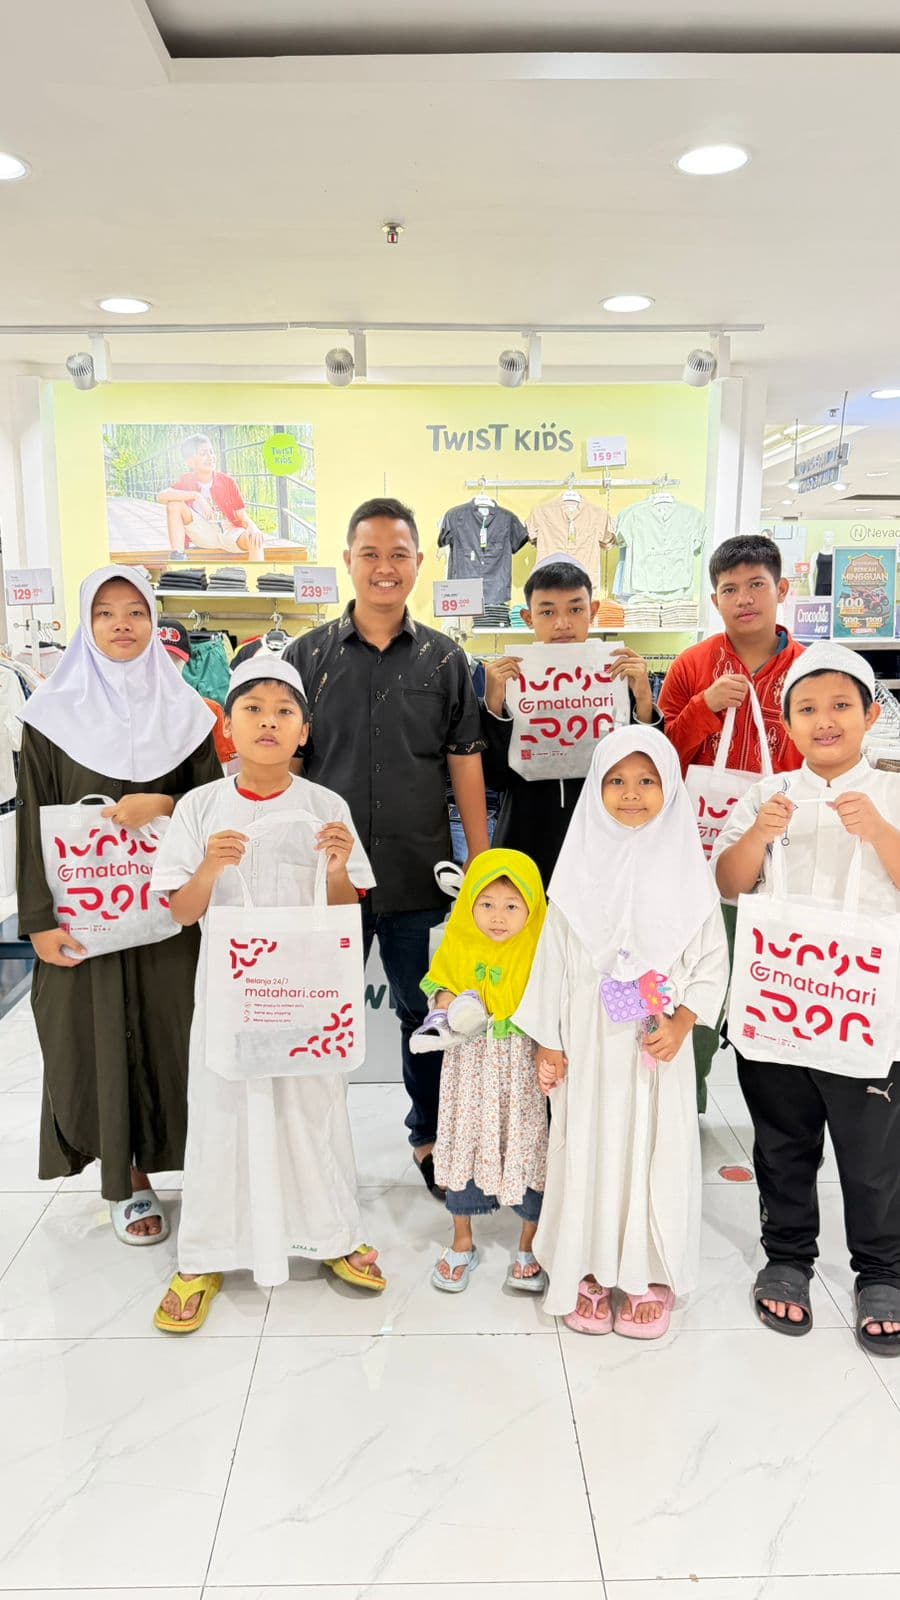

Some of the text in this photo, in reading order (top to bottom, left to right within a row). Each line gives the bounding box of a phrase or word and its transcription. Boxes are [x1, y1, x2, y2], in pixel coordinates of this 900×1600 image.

[425, 422, 574, 452] TWIST KIDS
[593, 452, 612, 461] 159
[841, 572, 889, 581] MINGGUAN
[13, 589, 31, 600] 129
[301, 586, 322, 597] 239
[442, 600, 457, 612] 89
[836, 597, 864, 608] 400
[537, 692, 614, 711] matahari
[76, 860, 153, 879] mataha
[245, 977, 272, 986] Belanja
[244, 986, 339, 999] matahari.com
[771, 969, 877, 1006] matahari
